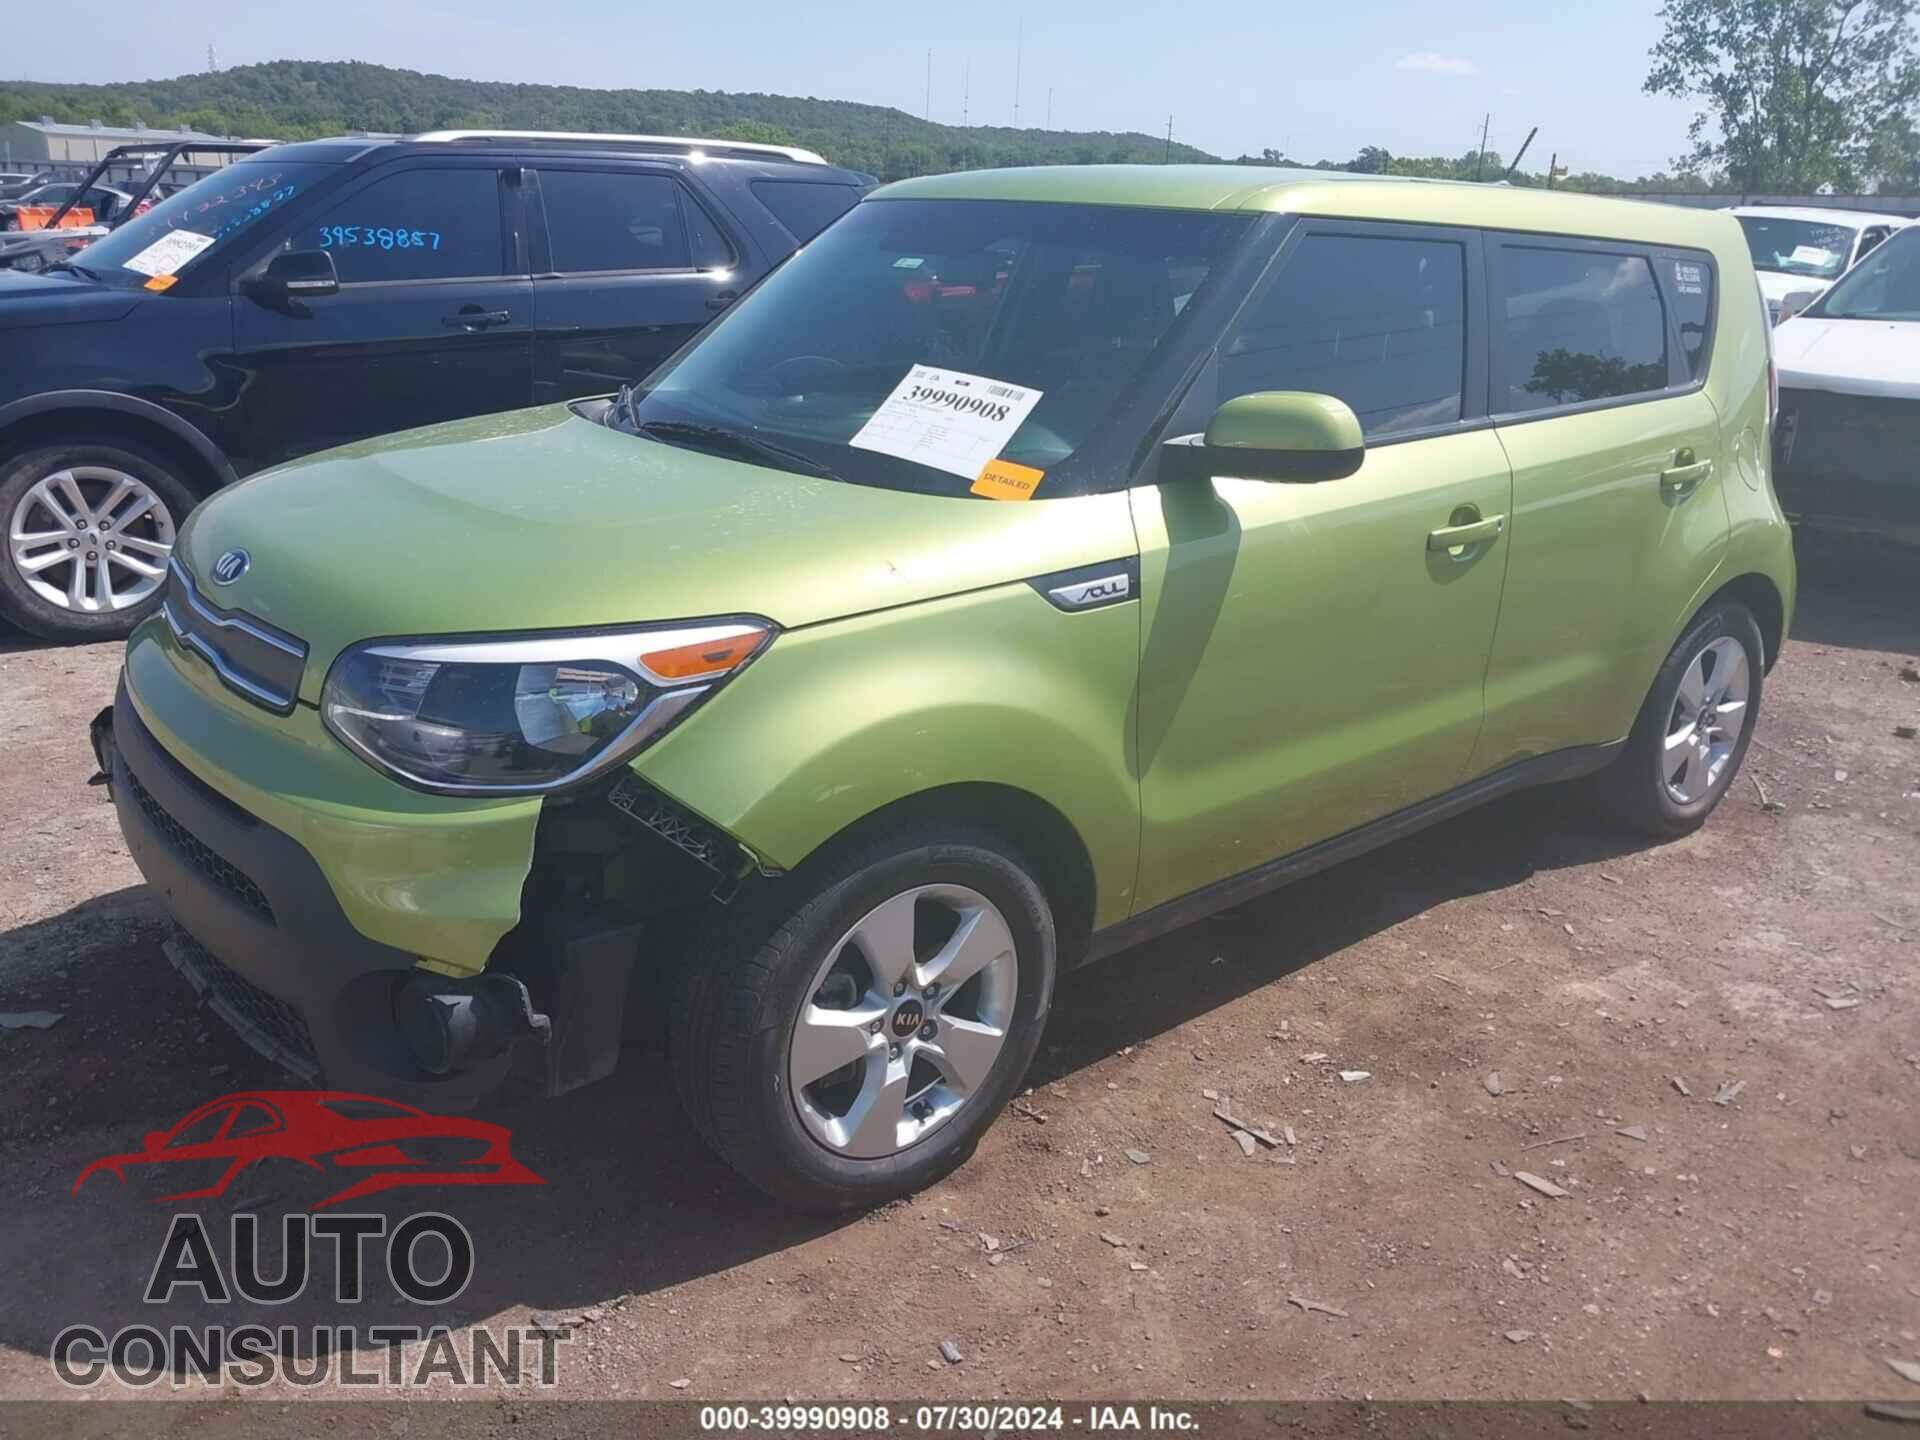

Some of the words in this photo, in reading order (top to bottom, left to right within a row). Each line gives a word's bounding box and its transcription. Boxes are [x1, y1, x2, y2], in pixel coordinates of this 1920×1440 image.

[319, 225, 441, 250] 39538857
[902, 384, 1011, 422] 39990908
[983, 471, 1031, 491] DETAILED
[895, 1012, 921, 1026] KIA
